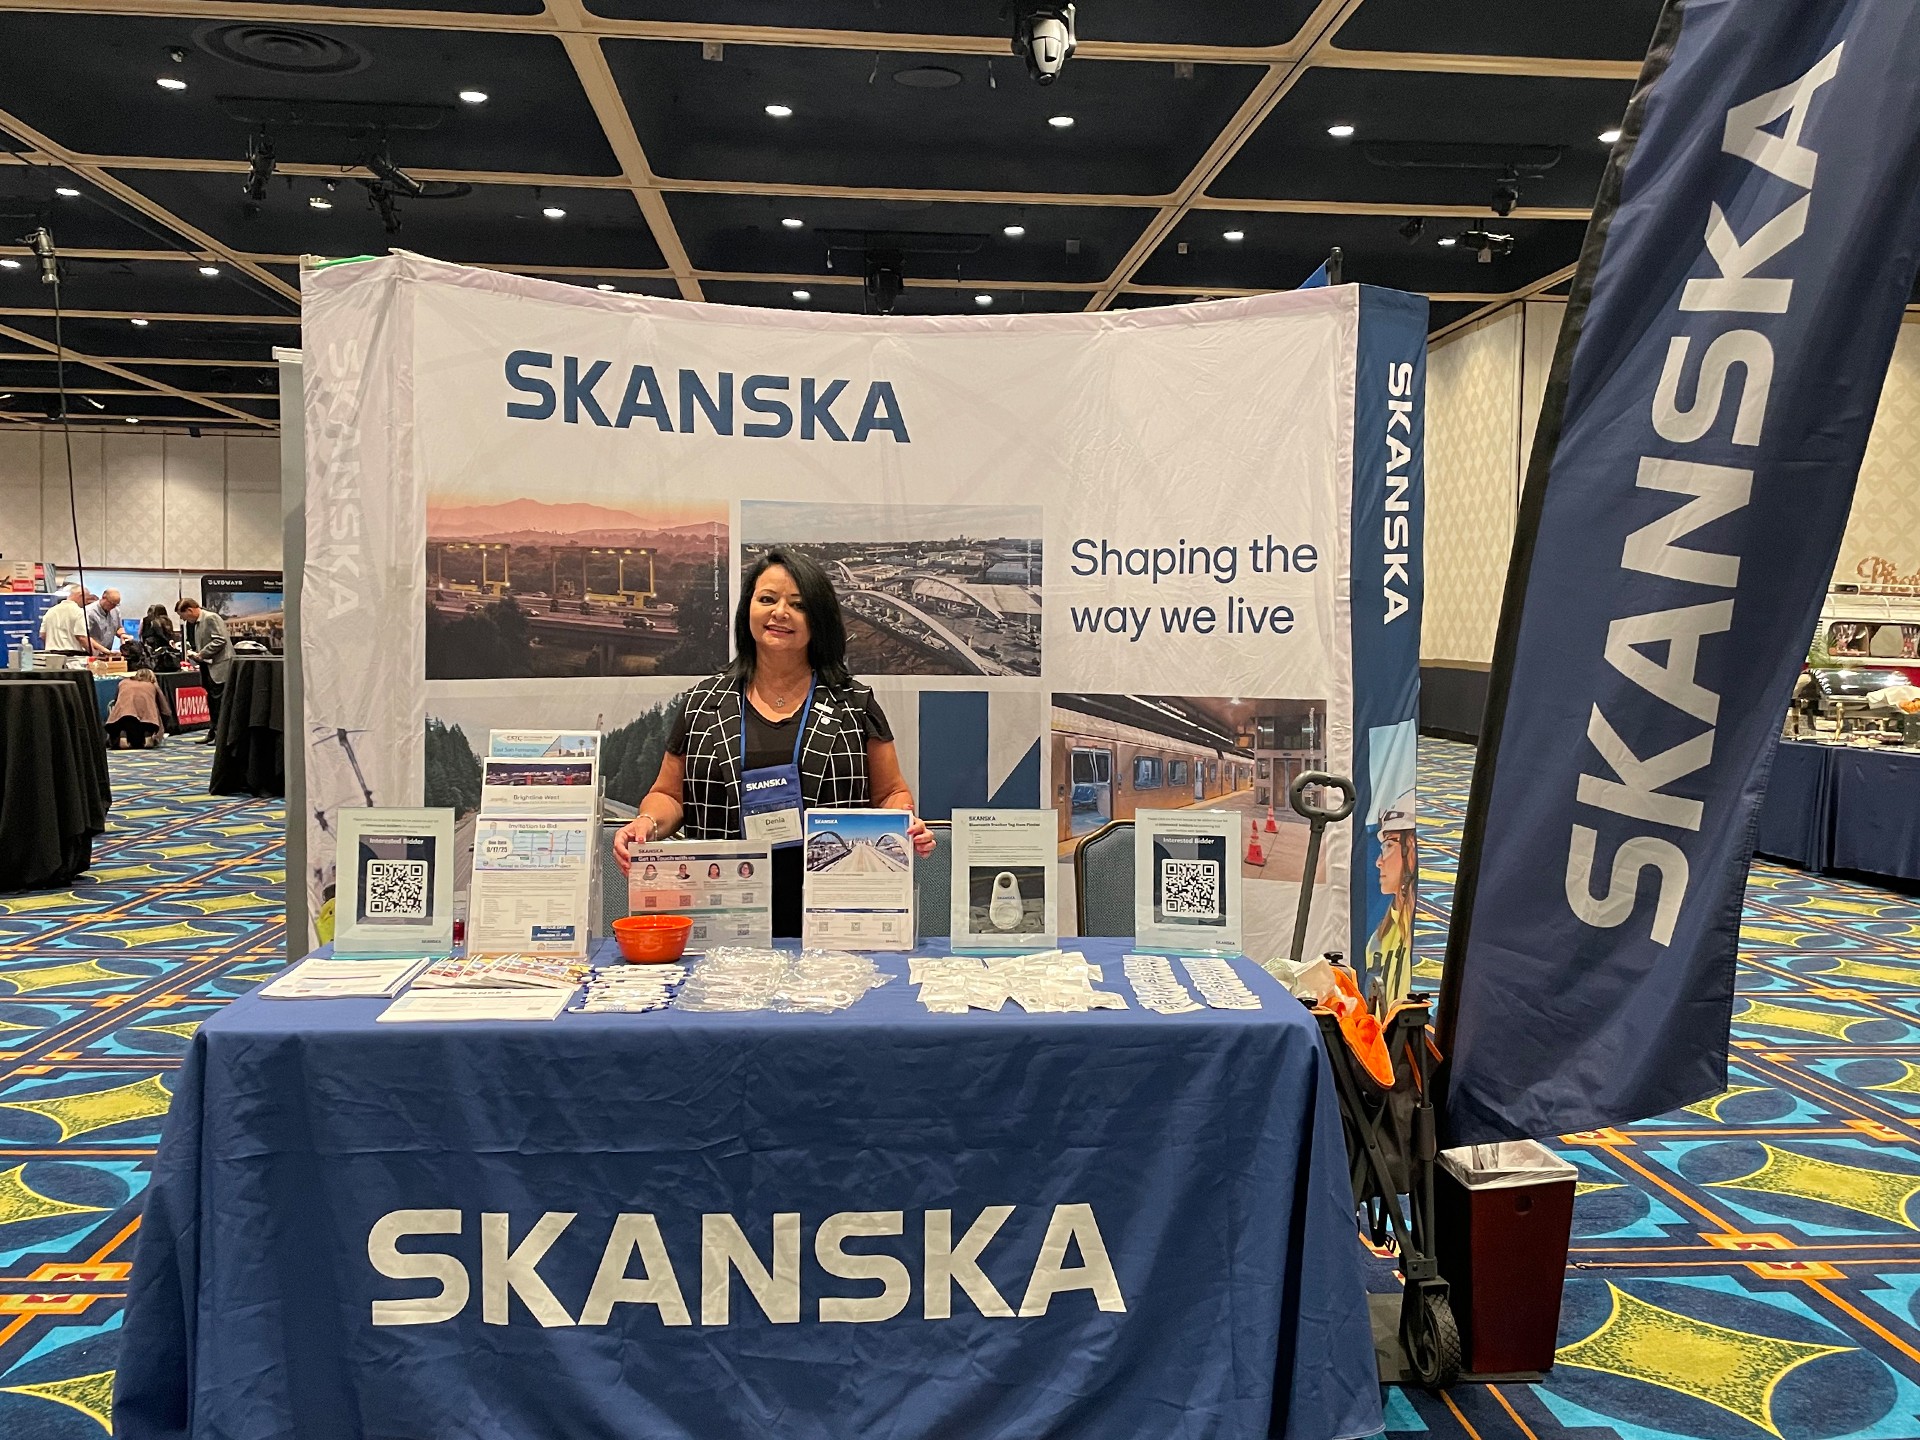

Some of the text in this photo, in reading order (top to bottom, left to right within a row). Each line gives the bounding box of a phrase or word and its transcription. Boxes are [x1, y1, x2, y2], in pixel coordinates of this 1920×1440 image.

[505, 350, 911, 443] SKANSKA
[1383, 362, 1413, 625] SKANSKA
[1564, 40, 1846, 948] SKANSKA
[1071, 534, 1318, 584] Shaping the
[1070, 596, 1294, 642] way we live
[746, 778, 788, 792] SKANSKA
[367, 1203, 1127, 1328] SKANSKA
